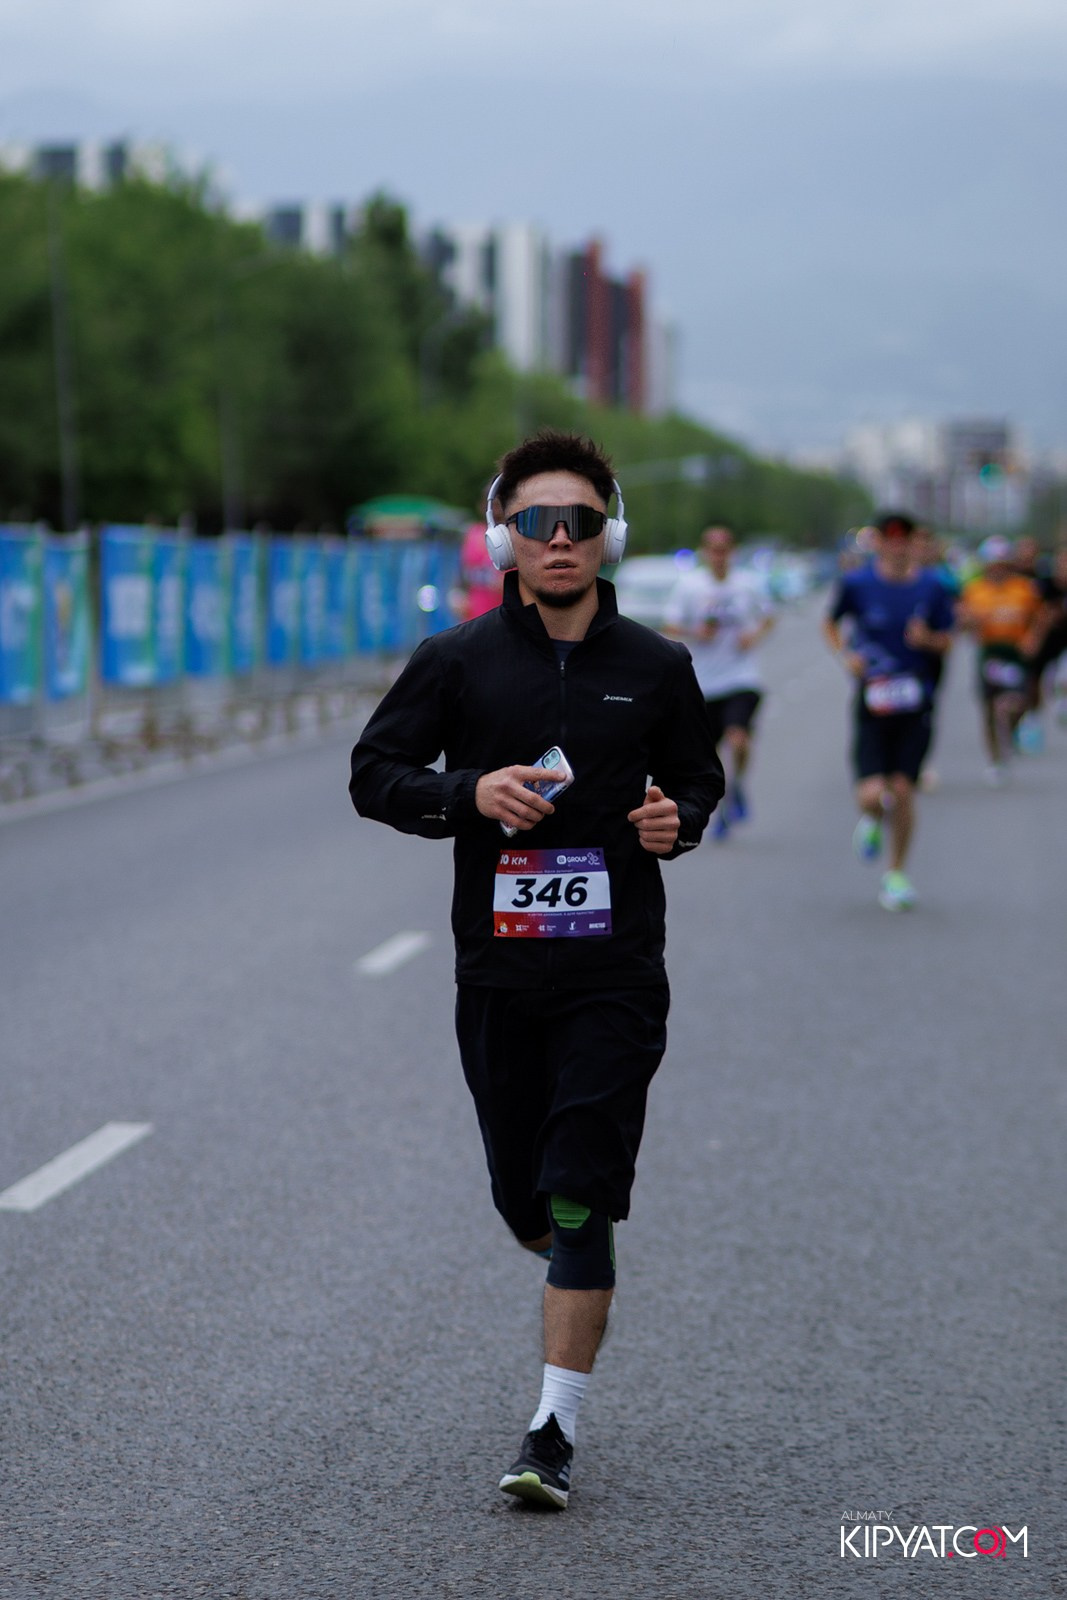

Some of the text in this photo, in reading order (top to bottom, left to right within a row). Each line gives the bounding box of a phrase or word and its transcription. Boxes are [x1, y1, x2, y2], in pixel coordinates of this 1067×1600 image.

[500, 854, 528, 865] 10 KM
[567, 855, 587, 863] GROUP
[511, 876, 589, 908] 346
